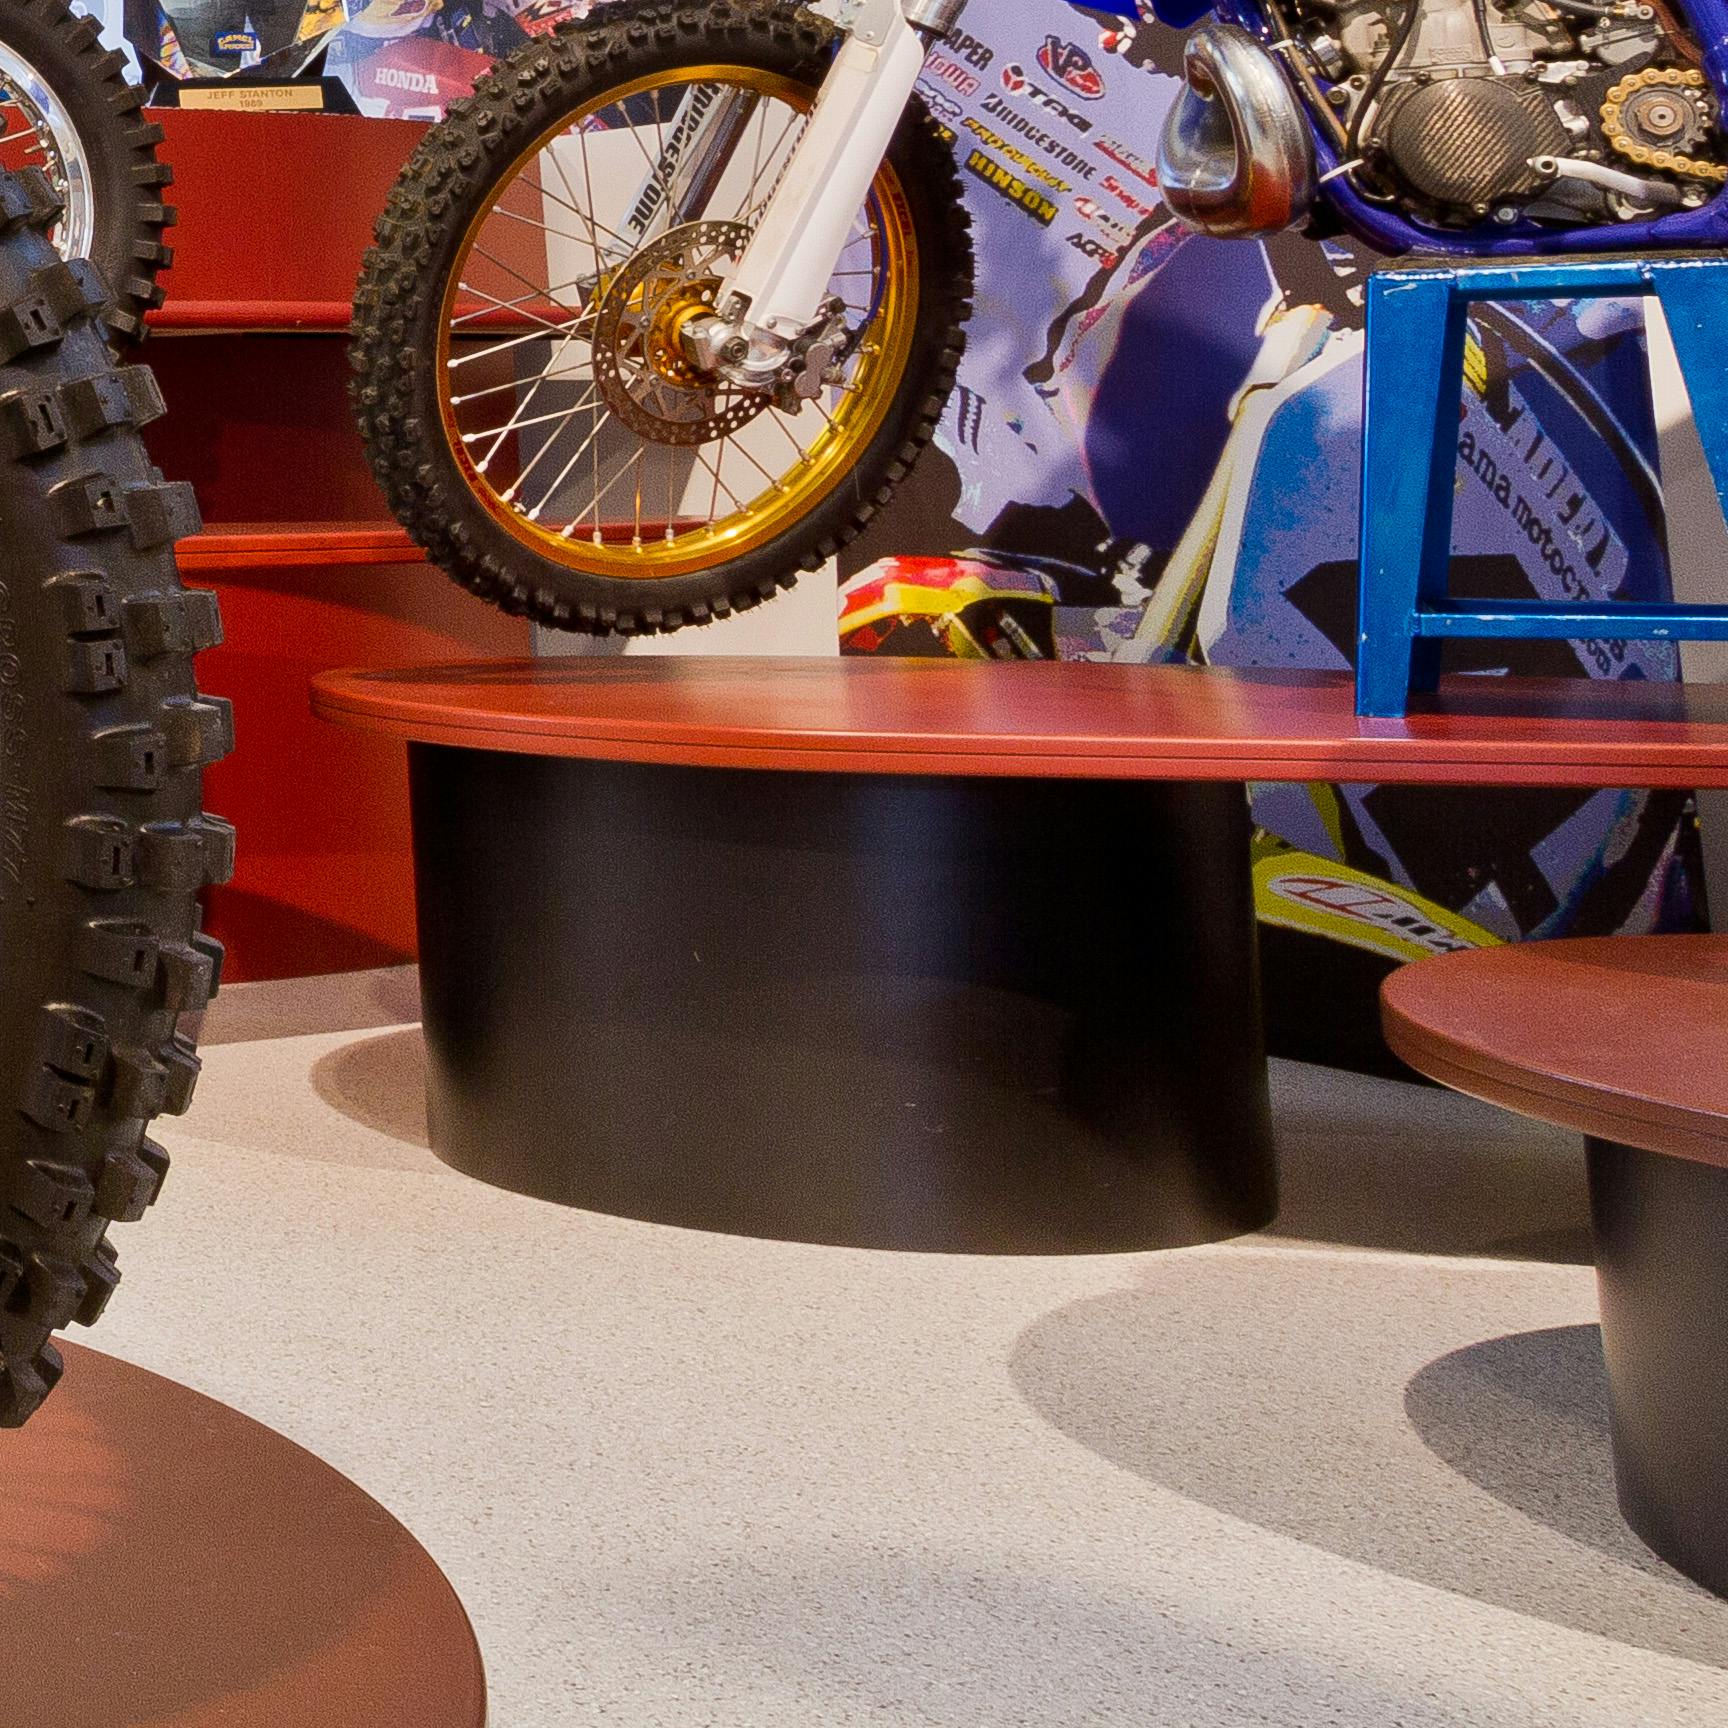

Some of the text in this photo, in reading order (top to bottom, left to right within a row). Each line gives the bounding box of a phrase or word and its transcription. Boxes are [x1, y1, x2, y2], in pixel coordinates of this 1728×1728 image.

[207, 88, 294, 101] JEFF STANTON
[373, 67, 439, 95] HONDA
[980, 93, 1098, 181] BRIDGESTONE
[966, 148, 1059, 225] HINSON
